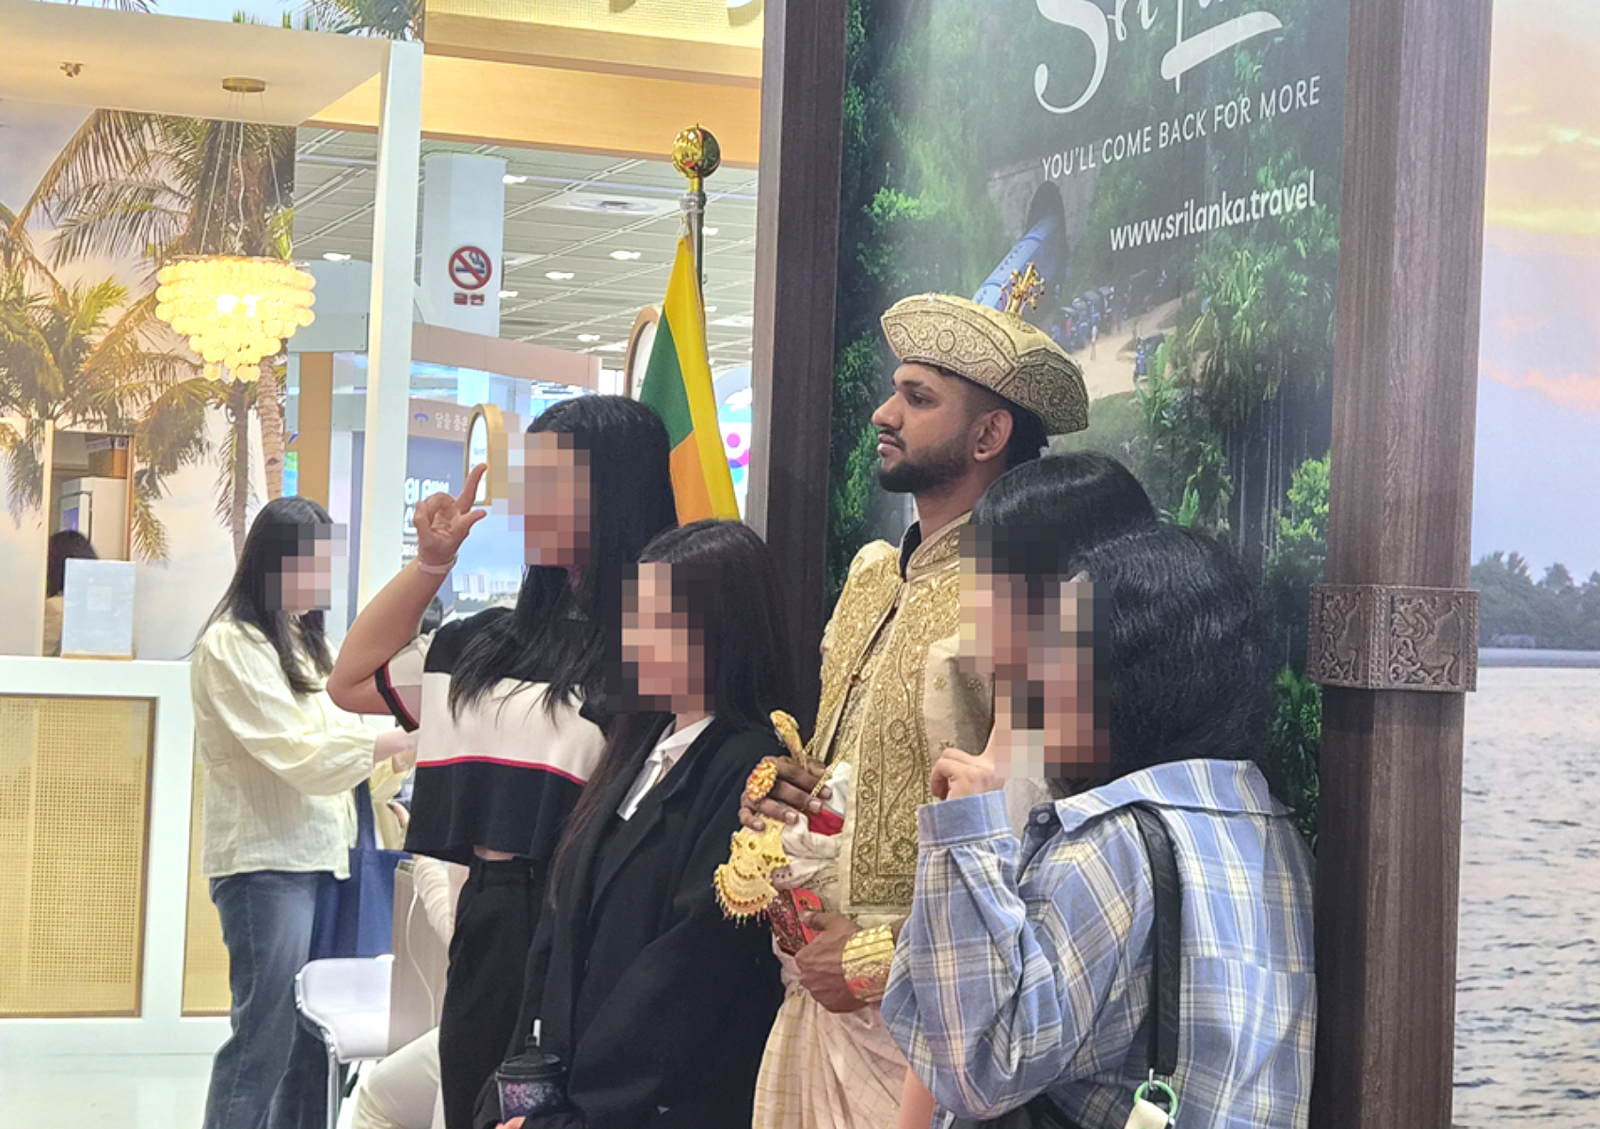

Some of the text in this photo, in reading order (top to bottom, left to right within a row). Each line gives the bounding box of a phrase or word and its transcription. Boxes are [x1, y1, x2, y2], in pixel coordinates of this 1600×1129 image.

[1041, 75, 1321, 181] YOU'LL COME BACK FOR MORE
[1110, 170, 1317, 251] www.srilanka.travel
